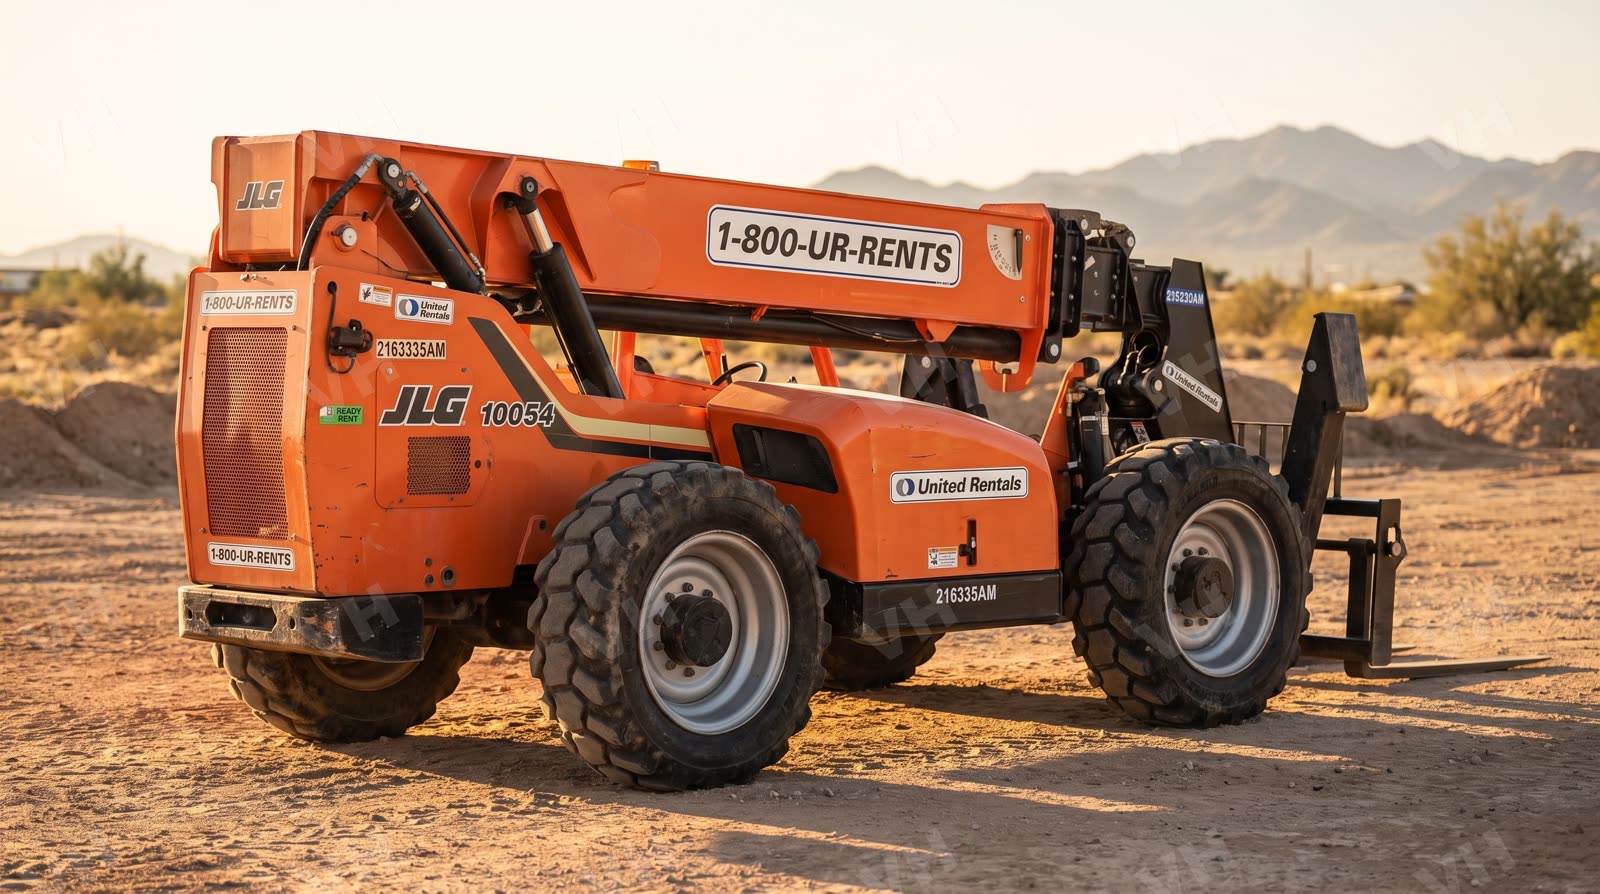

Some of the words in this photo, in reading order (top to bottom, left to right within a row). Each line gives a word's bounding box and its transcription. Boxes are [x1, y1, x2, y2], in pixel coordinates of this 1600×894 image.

[235, 180, 285, 211] JLG
[718, 221, 953, 273] 1-800-UR-RENTS
[204, 295, 294, 310] 1-800-UR-RENTS
[420, 301, 449, 312] United
[420, 310, 451, 321] Rentals
[377, 340, 445, 358] 2163335AM
[1174, 371, 1197, 391] United
[1195, 386, 1219, 407] Rentals
[336, 407, 362, 415] READY
[378, 385, 473, 426] JLG
[480, 401, 556, 428] 10054
[338, 415, 359, 423] RENT
[918, 477, 967, 495] United
[970, 475, 1022, 492] Rentals
[211, 547, 291, 566] 1-800-UR-RENTS
[936, 584, 997, 604] 216335AM
